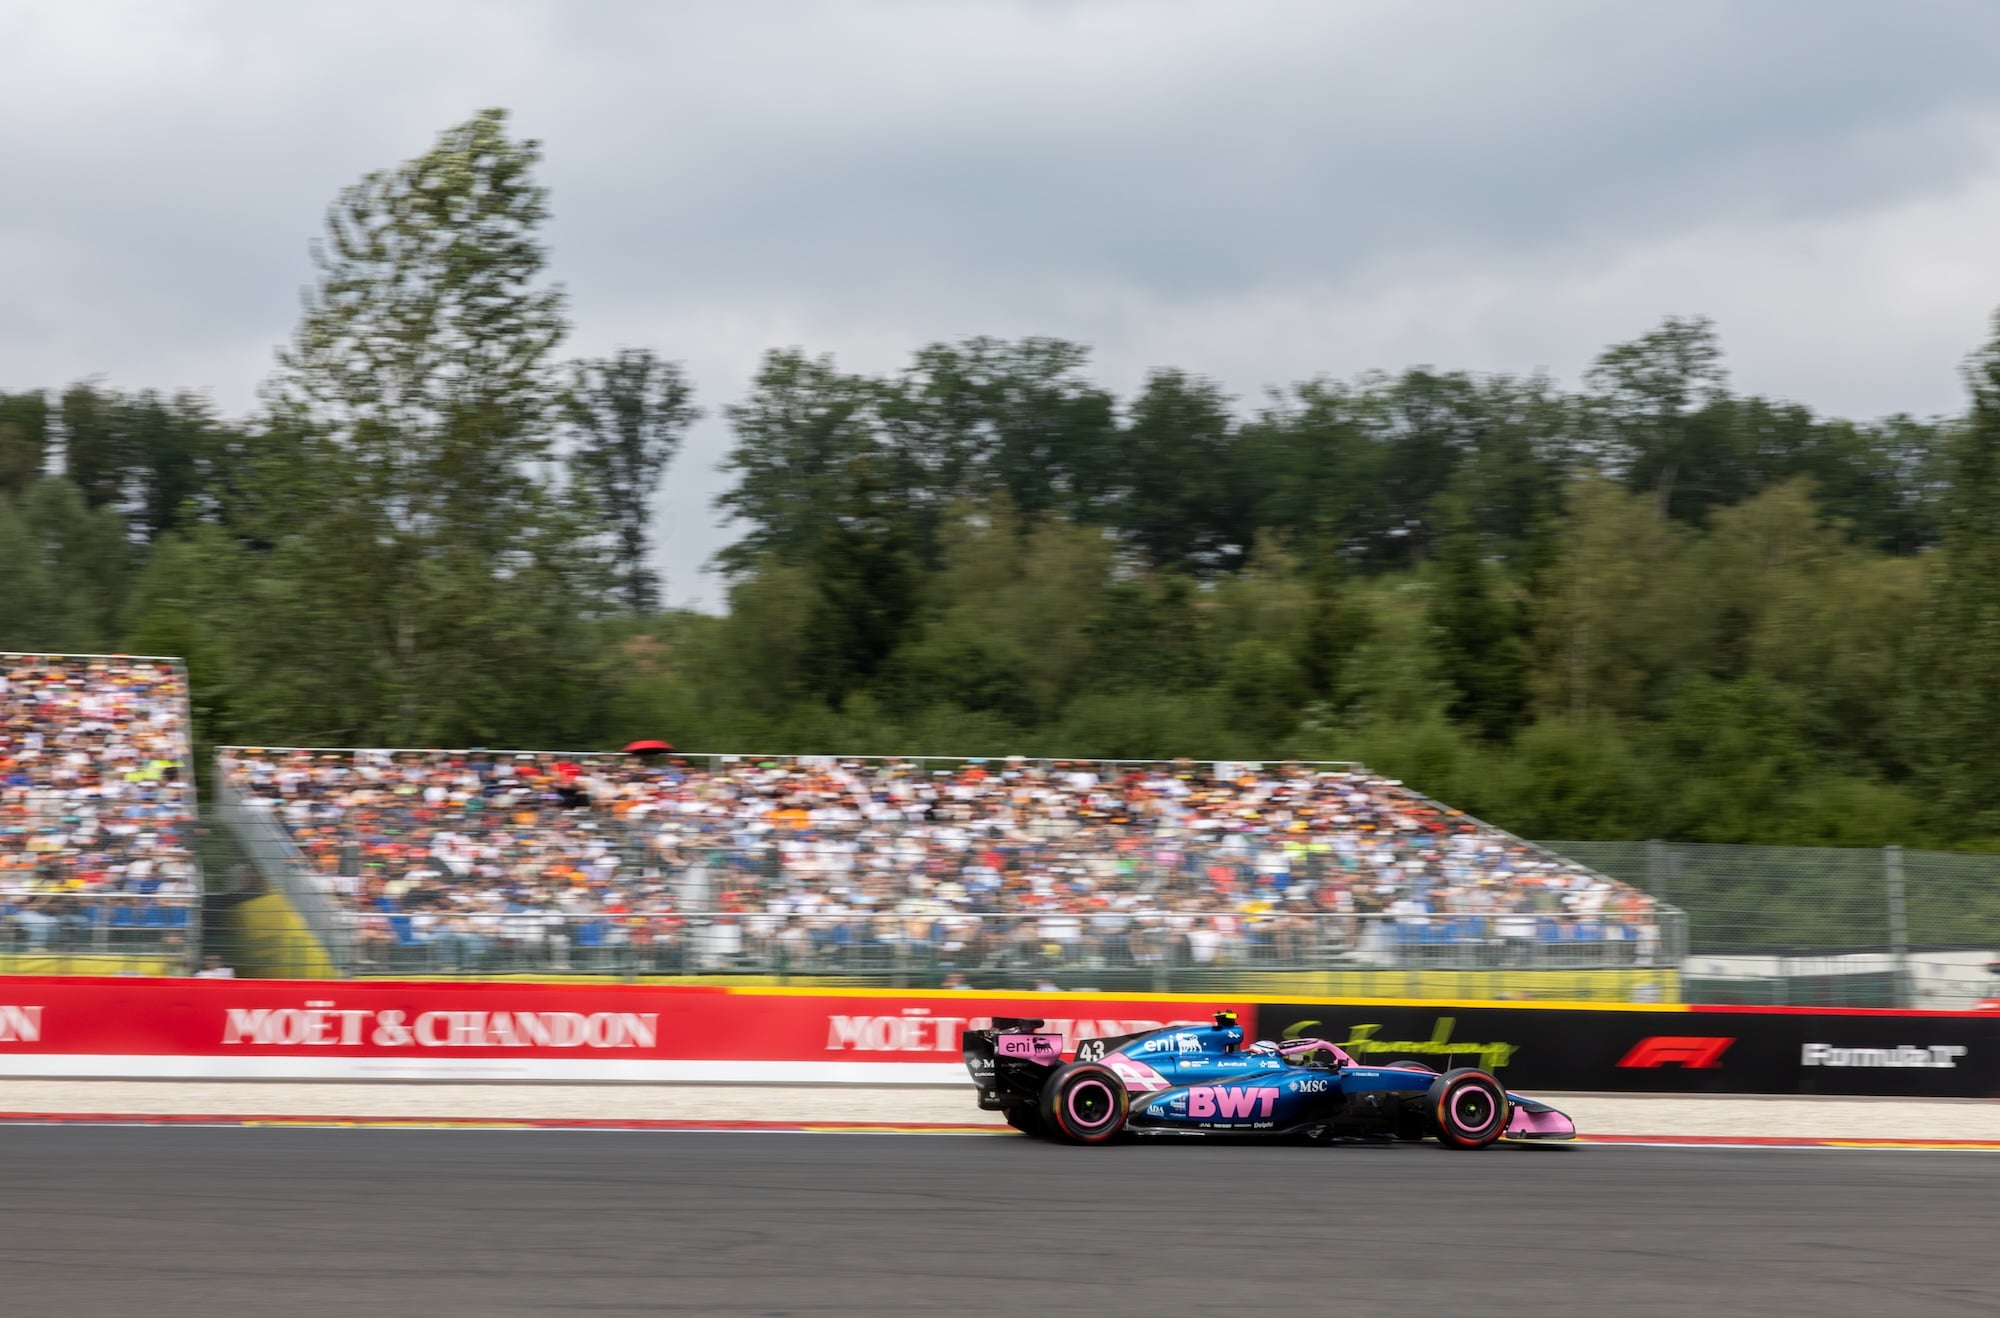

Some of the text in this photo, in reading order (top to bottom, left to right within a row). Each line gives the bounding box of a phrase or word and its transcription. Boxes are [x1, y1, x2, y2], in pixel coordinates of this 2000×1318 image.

[1006, 1038, 1030, 1052] eni
[1080, 1040, 1105, 1062] 43
[1143, 1035, 1175, 1052] eni
[1299, 1080, 1328, 1092] MSC
[1188, 1087, 1279, 1118] BWT
